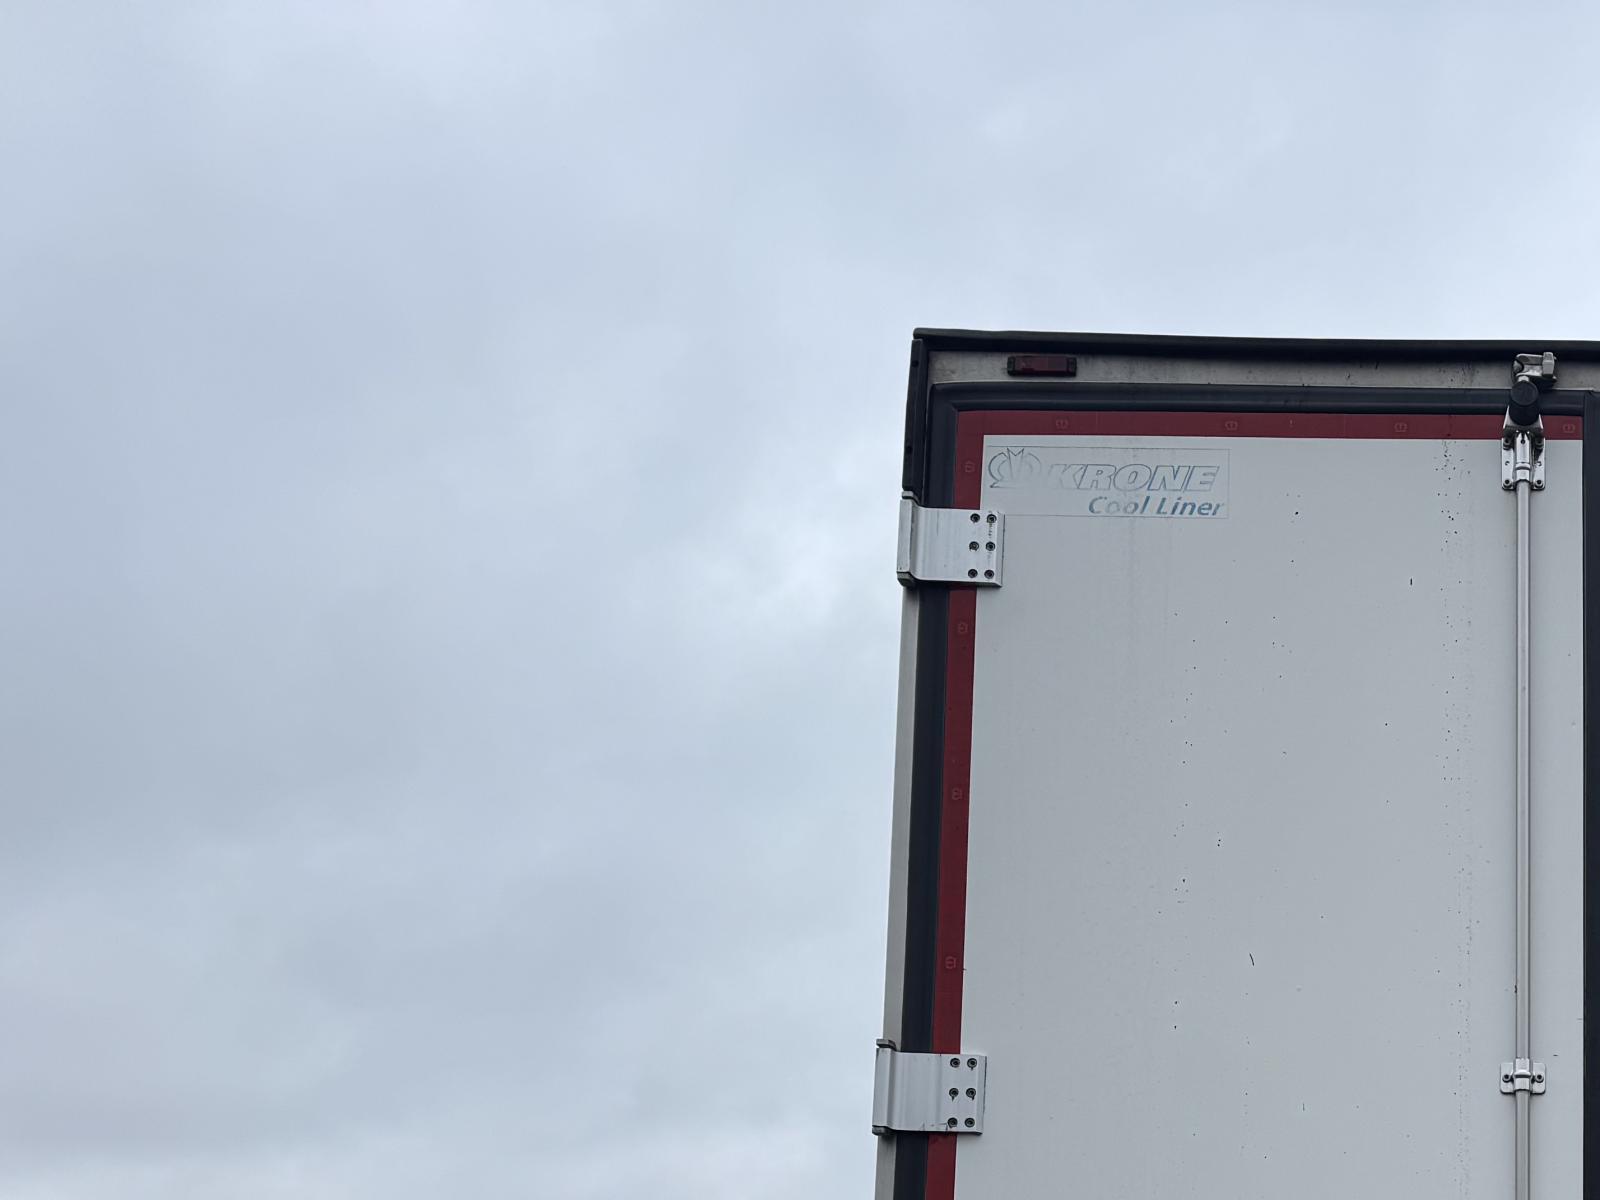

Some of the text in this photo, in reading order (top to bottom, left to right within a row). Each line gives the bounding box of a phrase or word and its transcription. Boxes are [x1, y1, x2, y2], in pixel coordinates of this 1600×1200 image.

[1050, 463, 1220, 492] KRONE
[1088, 495, 1224, 516] Cool Liner
